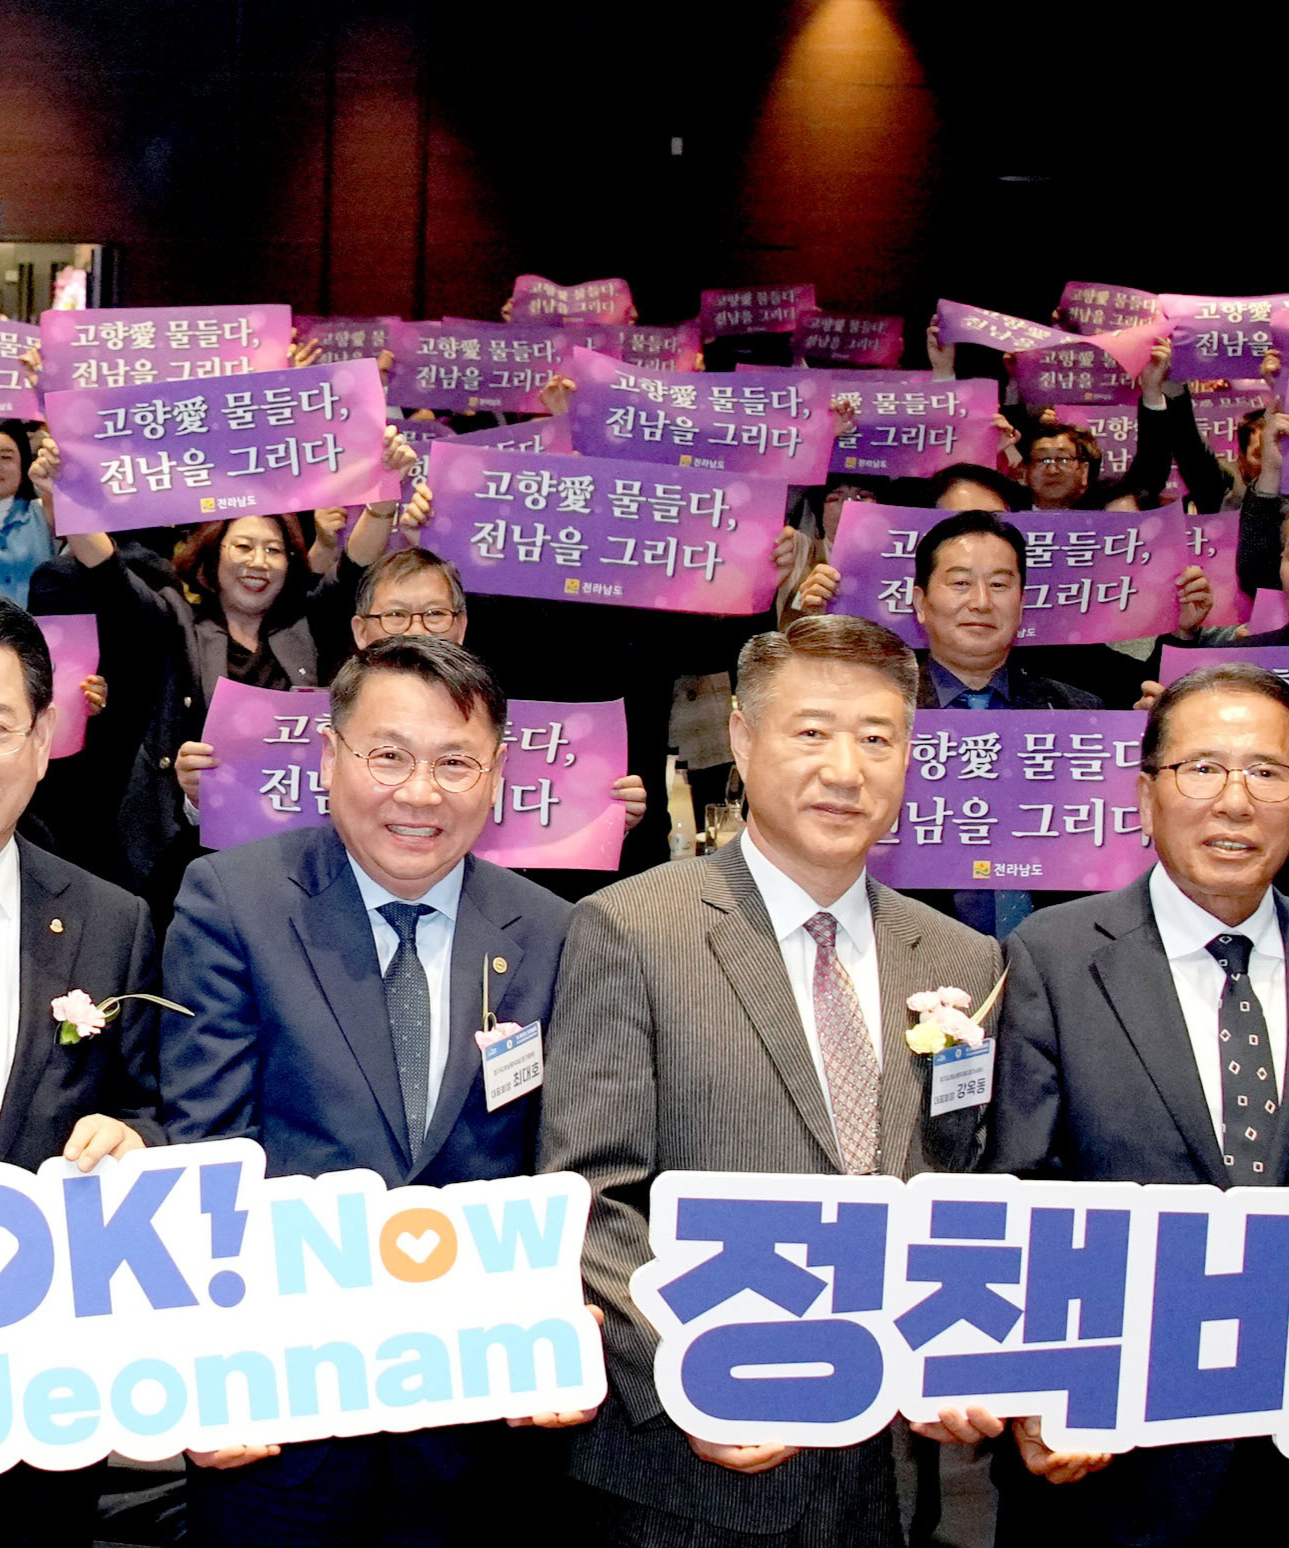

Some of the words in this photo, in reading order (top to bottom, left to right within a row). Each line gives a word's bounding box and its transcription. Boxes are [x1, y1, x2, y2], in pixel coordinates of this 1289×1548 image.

[71, 320, 157, 352] 고향愛
[165, 318, 262, 351] 물들다,
[71, 358, 158, 388] 전남을
[610, 369, 698, 411] 고향愛
[706, 385, 812, 419] 물들다,
[94, 394, 210, 442] 고향愛
[221, 381, 351, 433] 물들다,
[871, 391, 968, 418] 물들다,
[605, 404, 701, 446] 전남을
[706, 421, 804, 459] 그리다
[869, 423, 959, 454] 그리다
[99, 446, 216, 496] 전남을
[226, 433, 346, 480] 그리다
[473, 469, 596, 515] 고향愛
[606, 478, 738, 533] 물들다,
[469, 519, 591, 567] 전남을
[598, 535, 724, 583] 그리다
[1025, 527, 1151, 569] 물들다,
[1022, 576, 1138, 615] 그리다
[993, 861, 1044, 878] 전라남도
